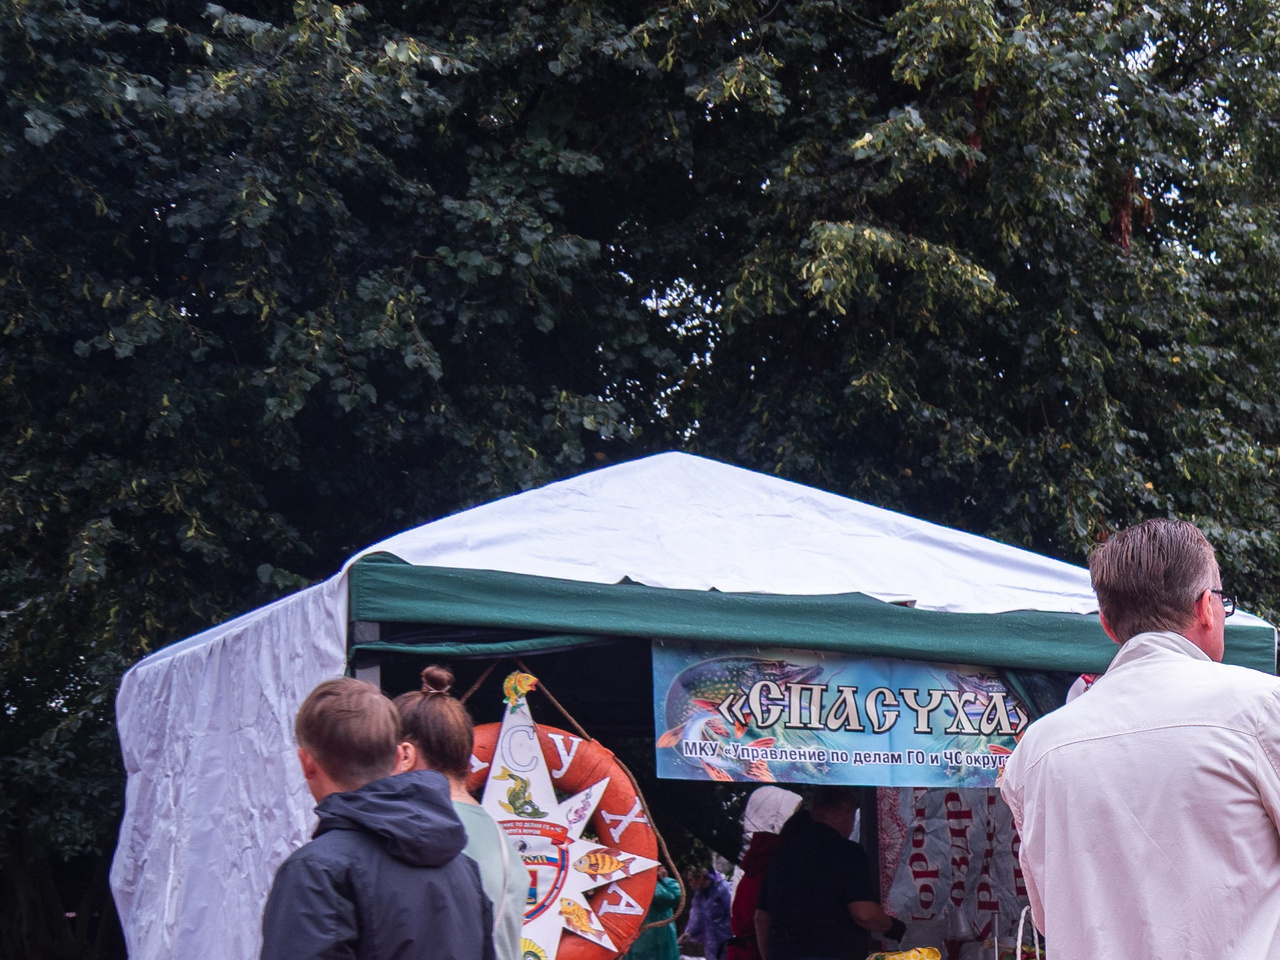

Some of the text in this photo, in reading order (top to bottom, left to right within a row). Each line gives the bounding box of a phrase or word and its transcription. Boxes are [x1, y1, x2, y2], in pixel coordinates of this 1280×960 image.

[683, 741, 719, 757] МКУ
[724, 743, 826, 762] «Управление
[831, 750, 849, 762] по
[853, 751, 903, 765] делам
[907, 751, 926, 765] ГО
[930, 754, 939, 765] и
[943, 751, 963, 765] ЧС
